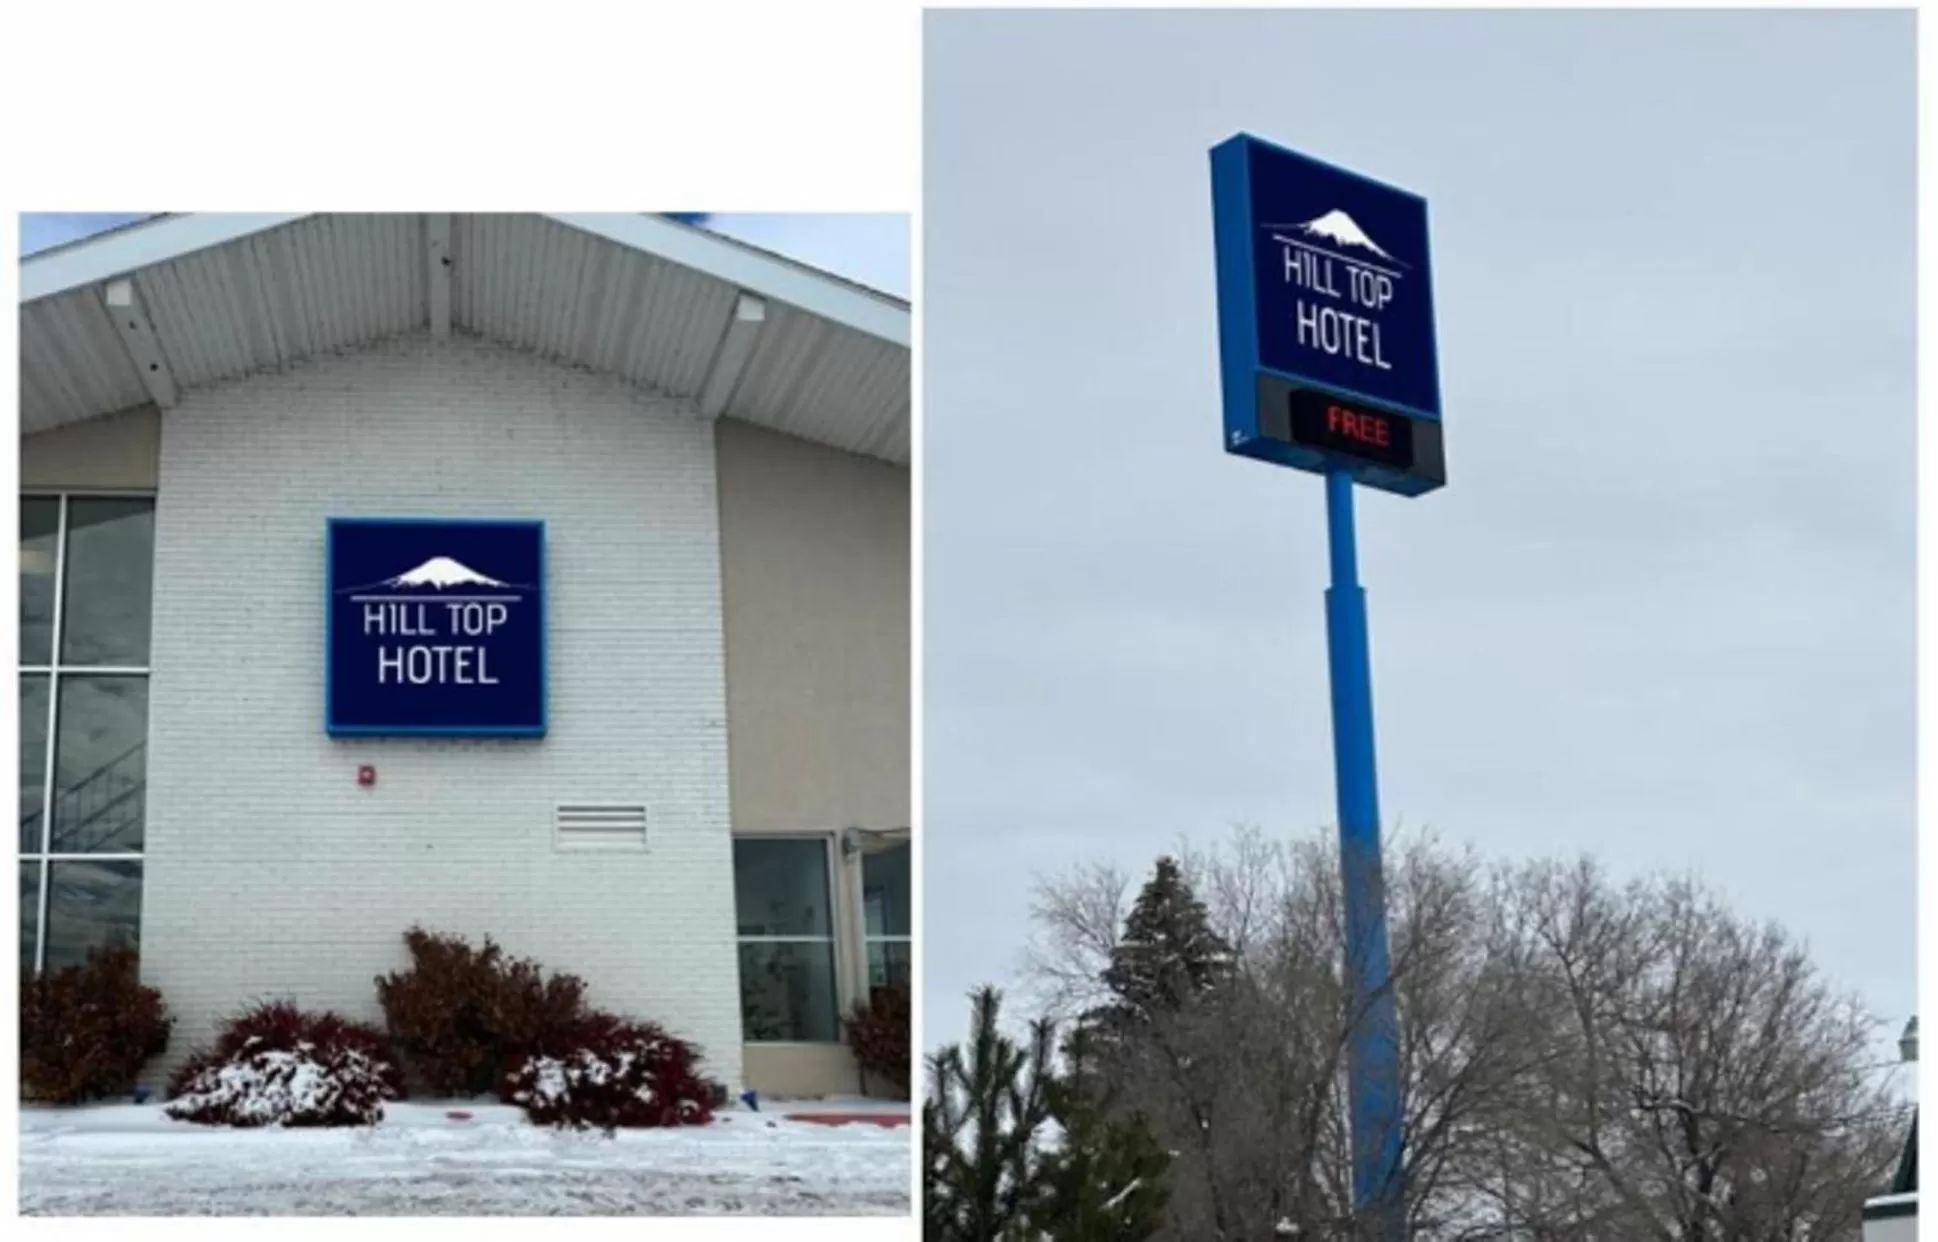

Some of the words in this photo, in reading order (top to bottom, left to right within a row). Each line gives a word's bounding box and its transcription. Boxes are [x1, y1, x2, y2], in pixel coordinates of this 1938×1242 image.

[1284, 245, 1341, 298] HILL
[1346, 265, 1393, 310] TOP
[1297, 299, 1392, 370] HOTEL
[1326, 405, 1391, 446] FREE
[363, 603, 436, 635] HILL
[446, 603, 508, 635] TOP
[378, 645, 500, 684] HOTEL
